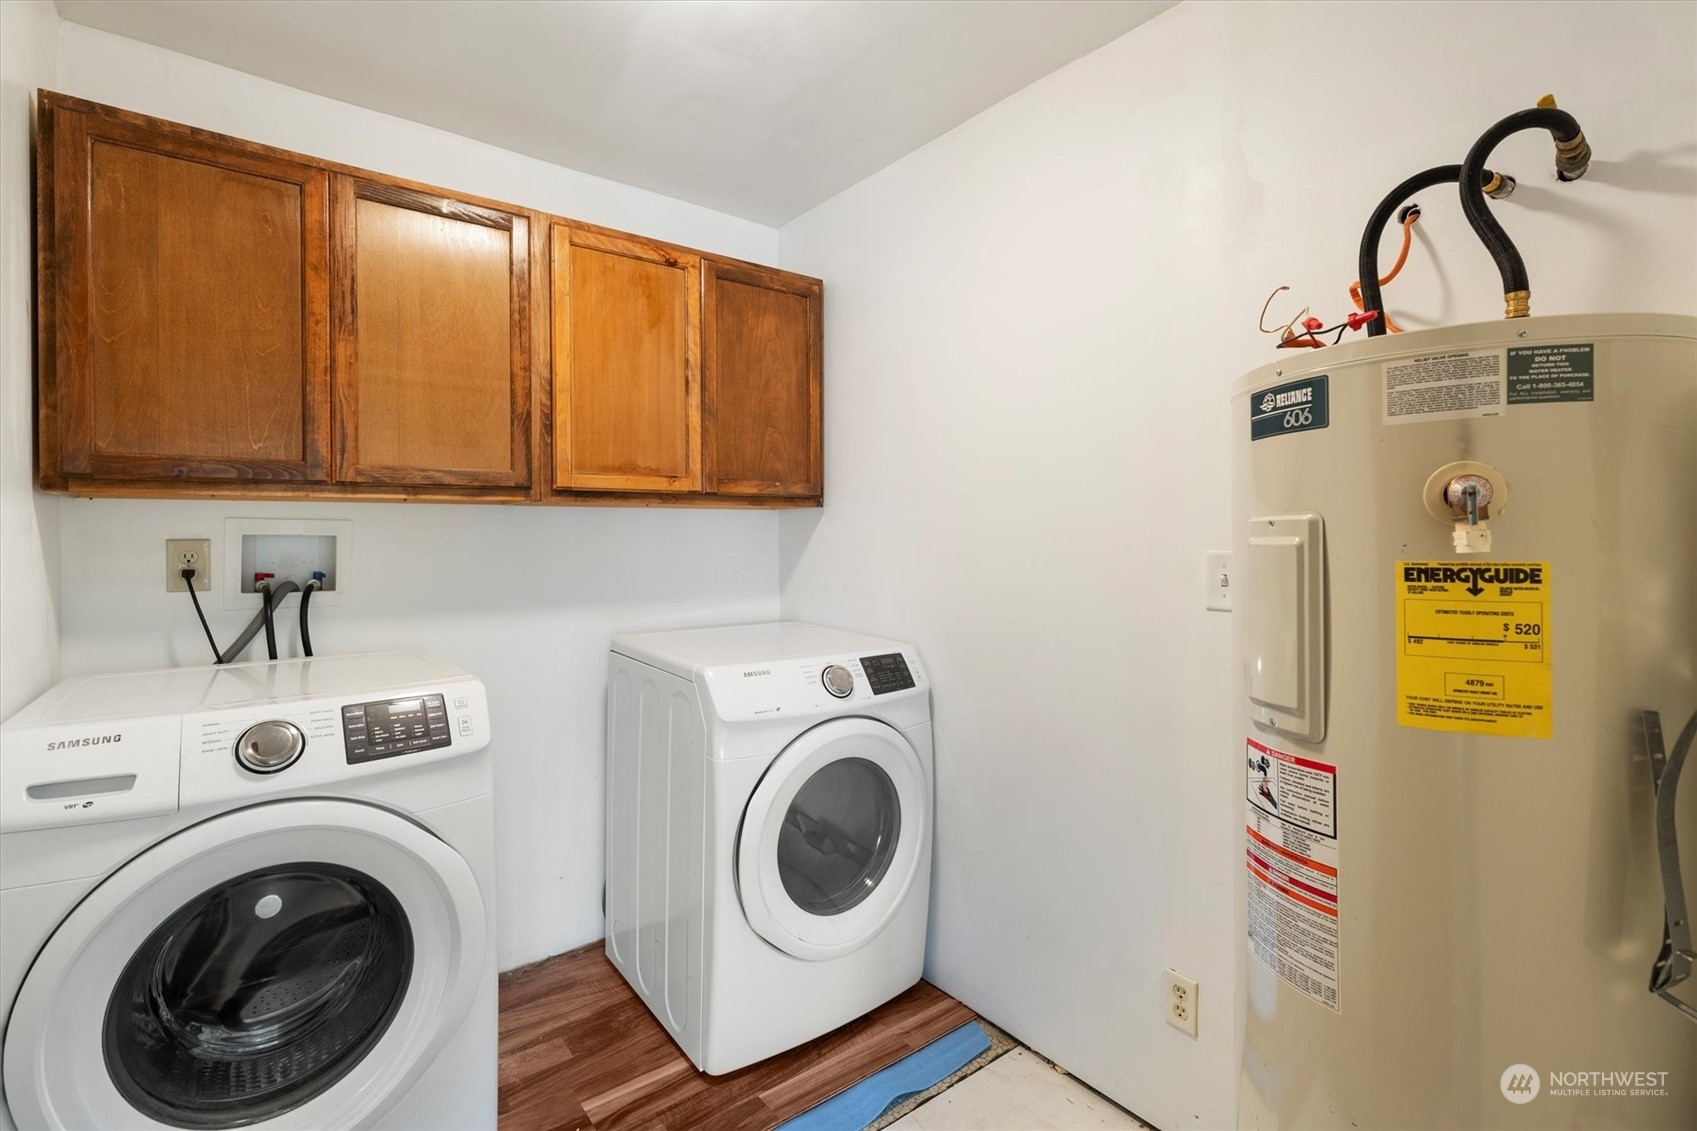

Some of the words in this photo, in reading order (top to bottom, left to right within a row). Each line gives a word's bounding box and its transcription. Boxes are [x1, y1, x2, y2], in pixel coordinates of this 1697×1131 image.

[1276, 387, 1312, 407] RELIANCE
[1283, 408, 1312, 428] 606
[1404, 567, 1542, 584] ENERGYGUIDE
[1503, 623, 1510, 632] $
[1515, 623, 1540, 635] 520
[47, 734, 122, 751] SAMSUNG
[1271, 750, 1296, 764] DANGER
